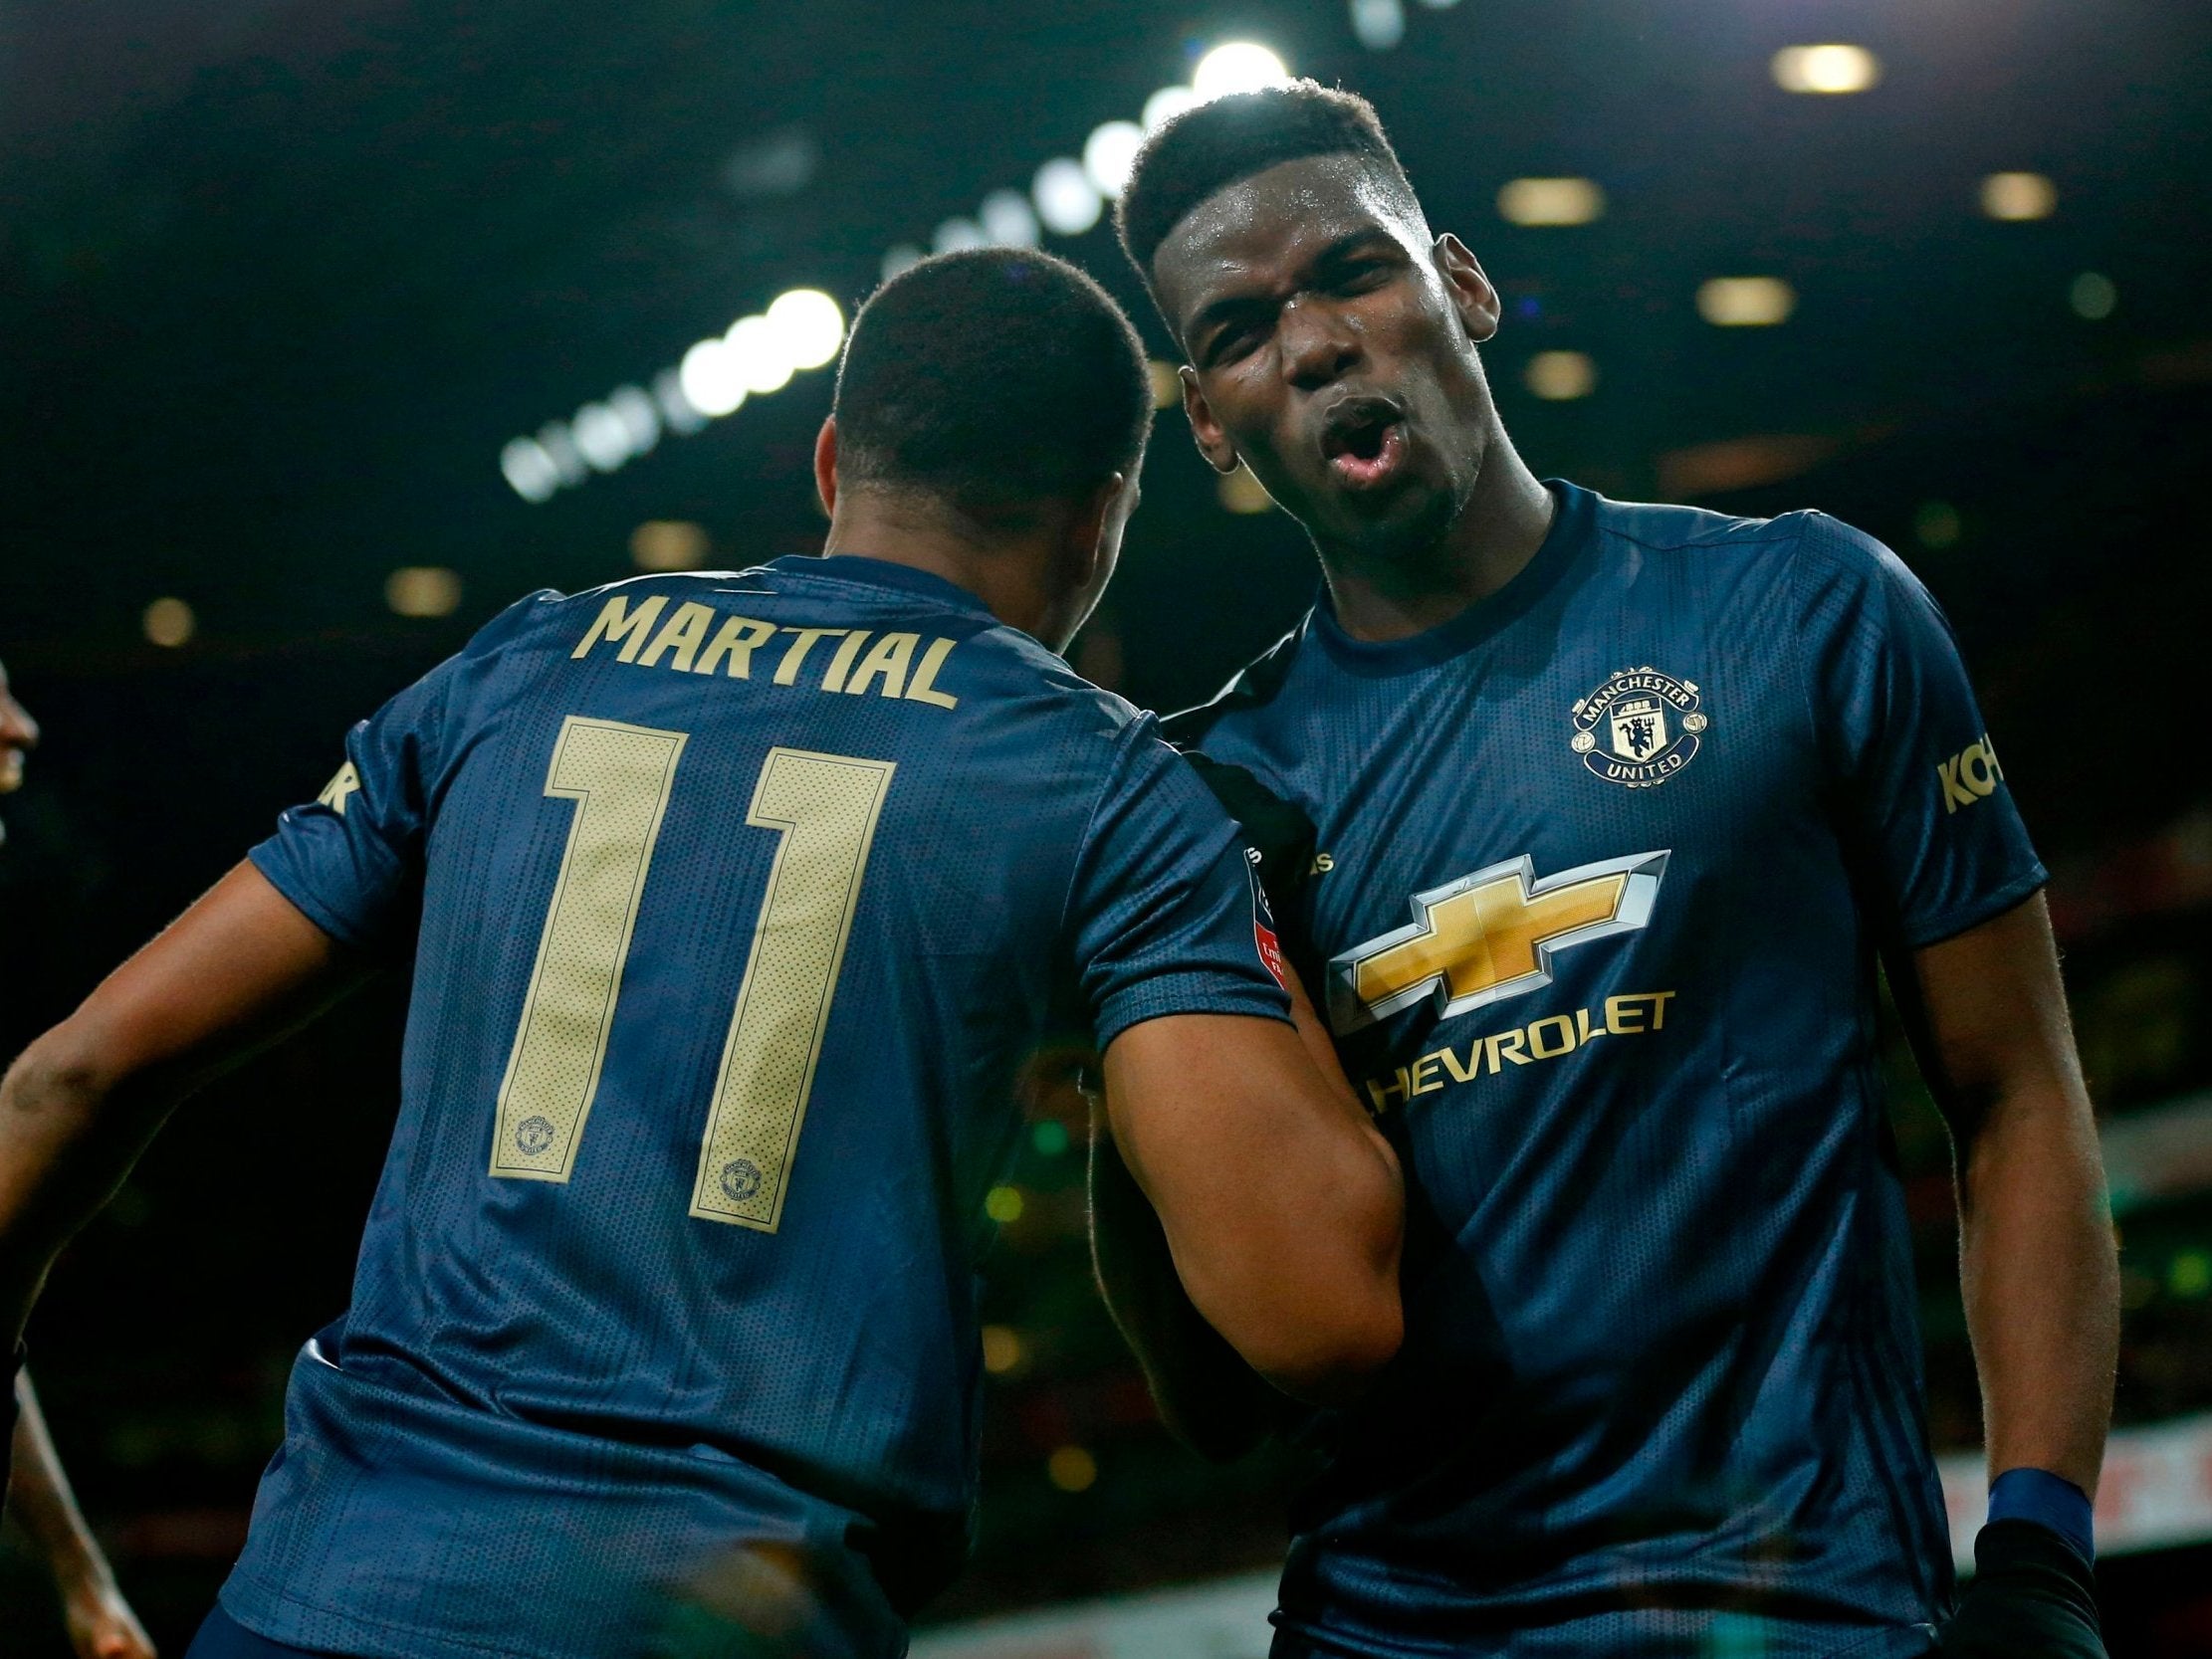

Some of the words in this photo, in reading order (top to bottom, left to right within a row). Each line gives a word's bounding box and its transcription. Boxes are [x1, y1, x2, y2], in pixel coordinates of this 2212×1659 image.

[570, 595, 958, 711] MARTIAL
[1583, 676, 1690, 723] MANCHESTER
[1606, 753, 1682, 780] UNITED
[489, 715, 898, 1234] 11
[1366, 991, 1676, 1116] HEVROLET
